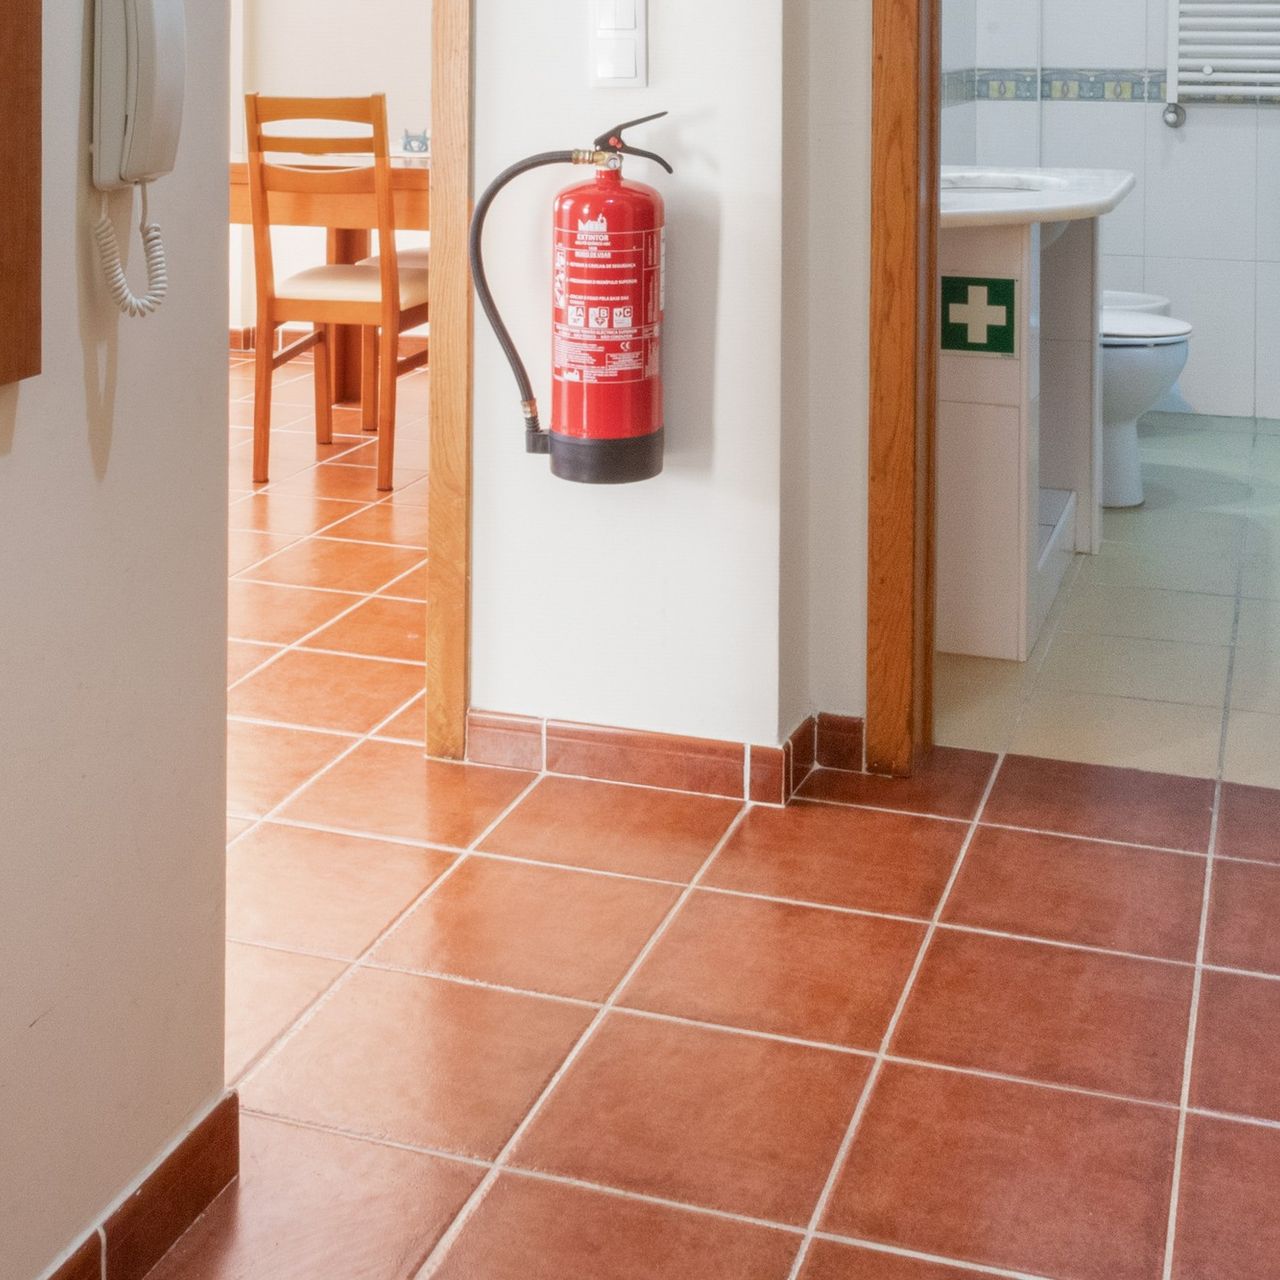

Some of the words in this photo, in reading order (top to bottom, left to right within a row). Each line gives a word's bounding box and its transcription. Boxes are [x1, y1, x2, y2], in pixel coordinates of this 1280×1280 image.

[577, 233, 609, 241] EXTINTOR
[600, 308, 607, 317] B
[624, 308, 631, 316] C
